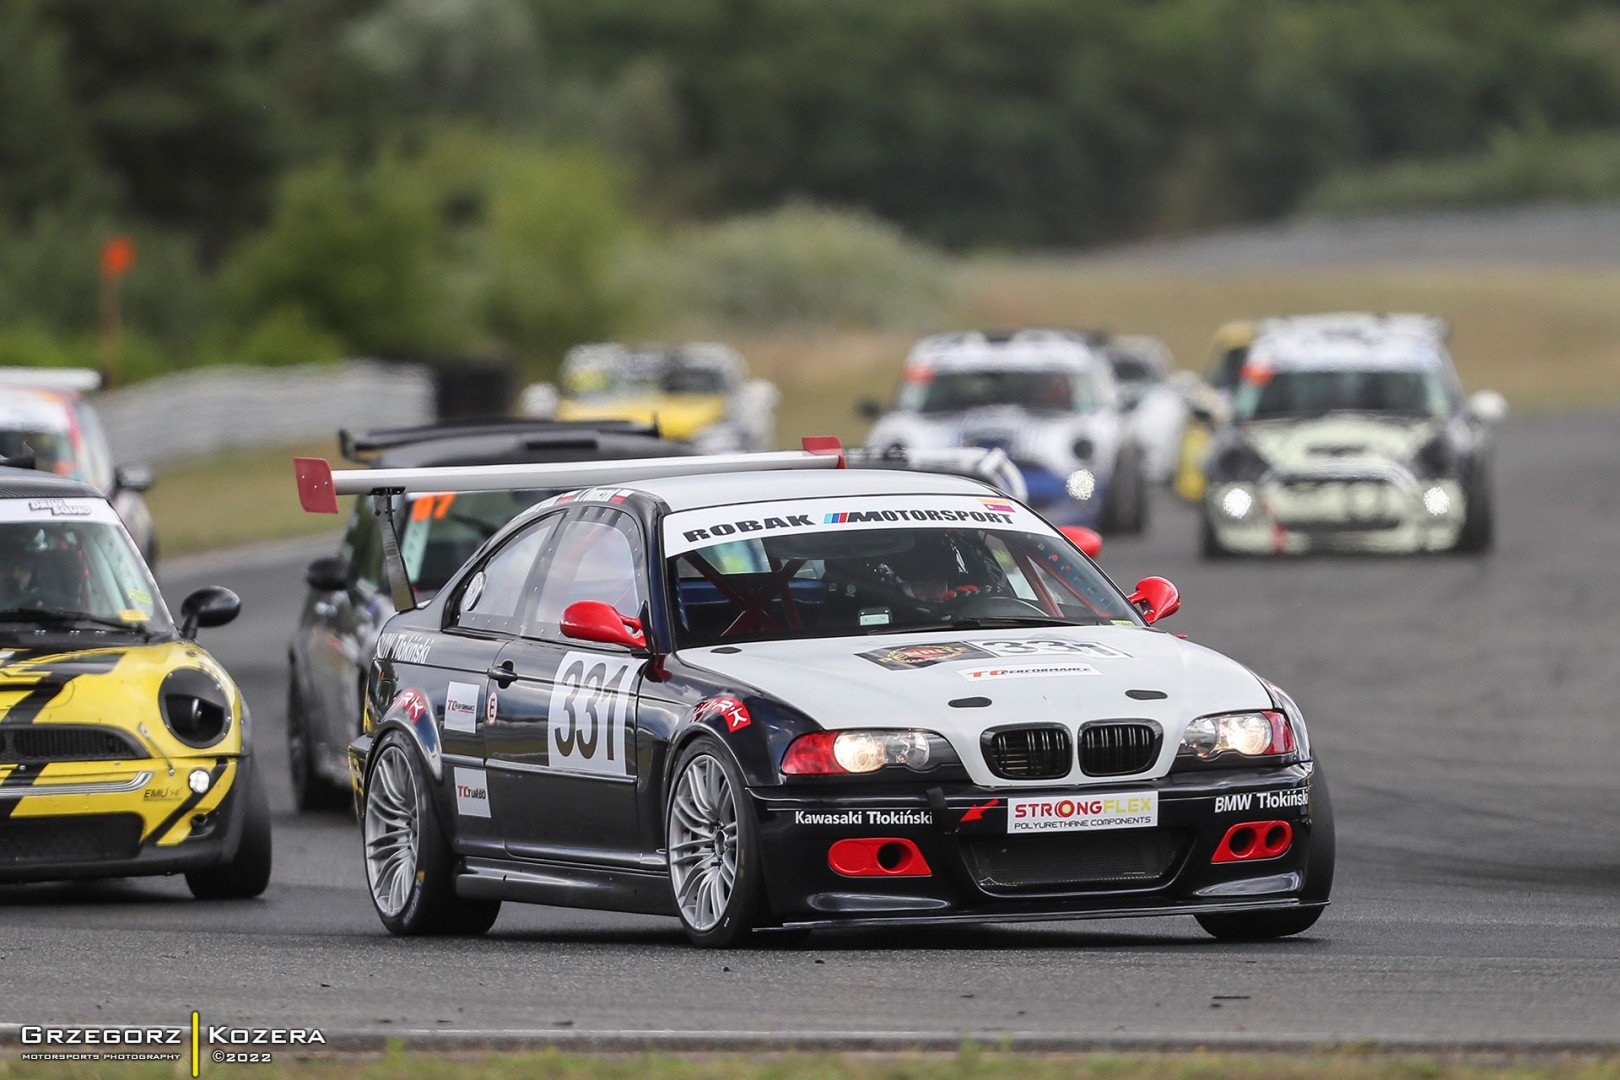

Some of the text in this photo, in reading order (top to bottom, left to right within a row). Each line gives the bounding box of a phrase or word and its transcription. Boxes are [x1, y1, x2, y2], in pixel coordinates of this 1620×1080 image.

[682, 509, 1014, 543] ROBAK MOTORSPORT
[982, 641, 1119, 657] 331
[554, 660, 629, 761] 331
[143, 787, 169, 798] EMU
[1014, 798, 1152, 818] STRONGFLEX
[1214, 794, 1252, 813] BMW
[795, 810, 933, 825] Kawasaki Tłokiński
[1014, 816, 1152, 830] POLYURETHANE COMPONENTS
